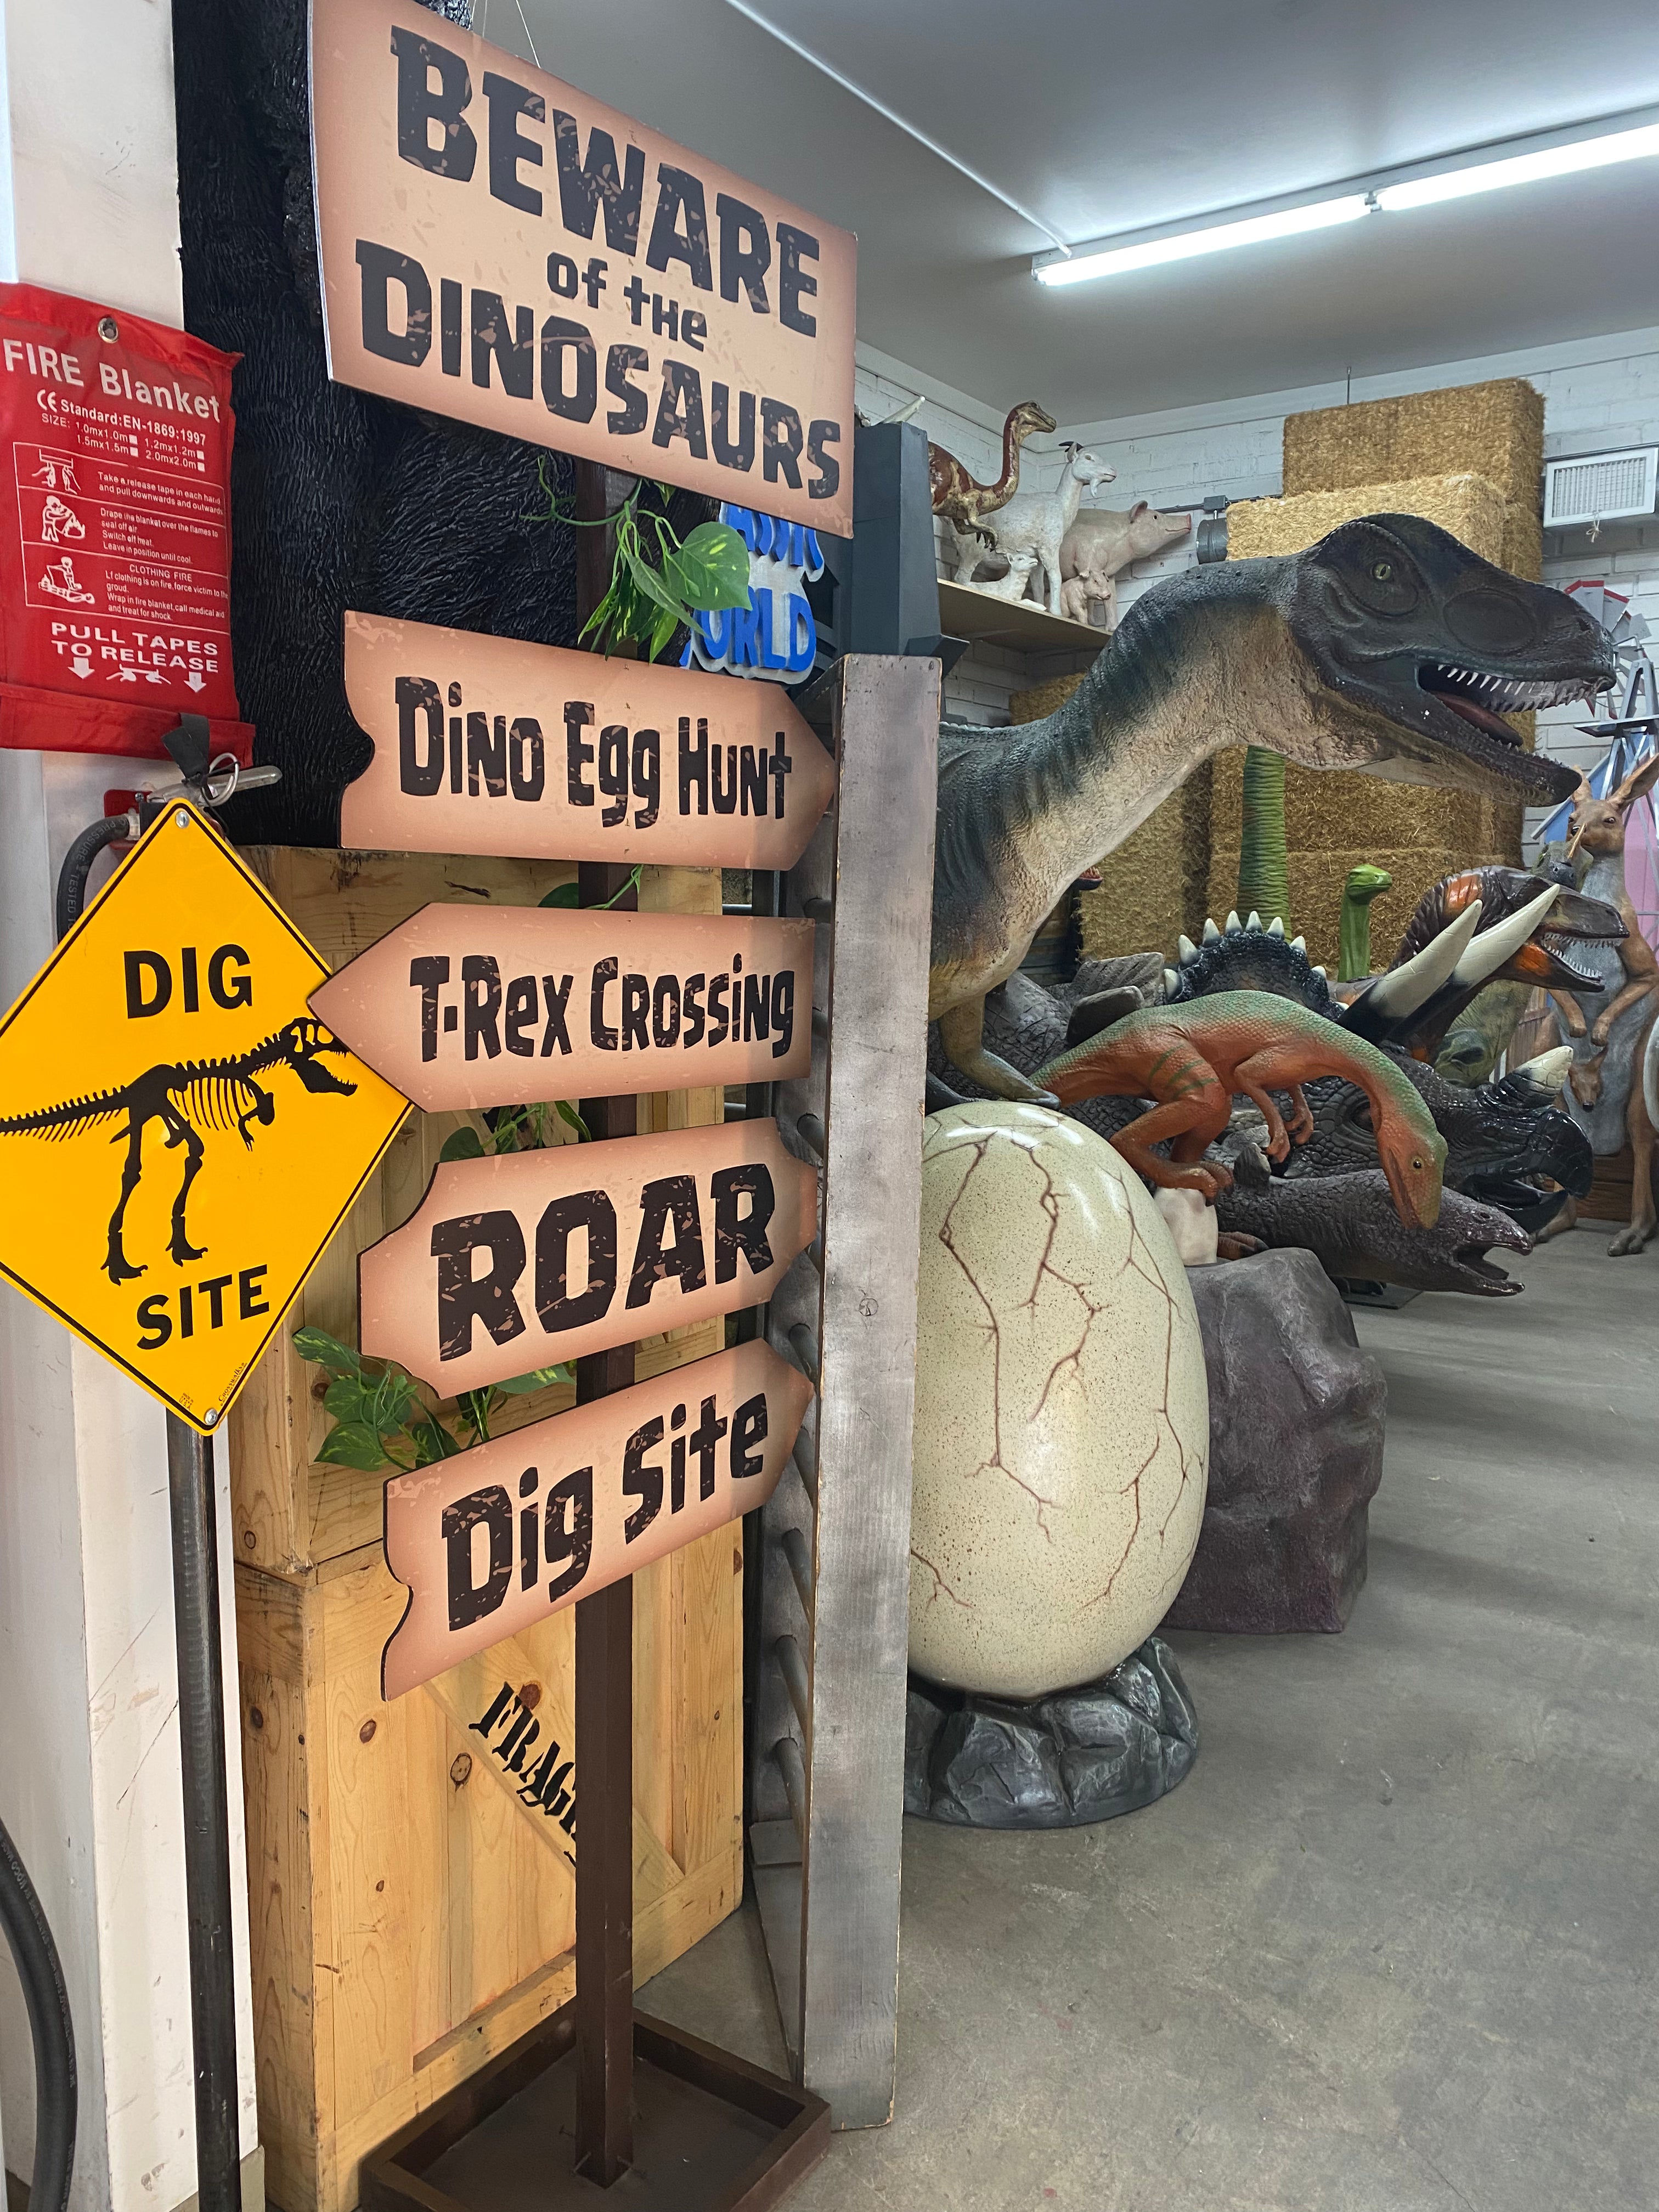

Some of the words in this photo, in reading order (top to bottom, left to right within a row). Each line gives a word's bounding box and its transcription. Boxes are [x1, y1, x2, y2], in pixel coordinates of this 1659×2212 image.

[390, 24, 820, 338] BEWARE
[3, 338, 84, 387] FIRE
[98, 362, 221, 423] Blanket
[355, 238, 841, 500] DINOSAURS
[41, 413, 70, 428] SIZE:
[98, 471, 119, 483] Take
[127, 479, 155, 490] release
[157, 484, 175, 495] tape
[176, 488, 183, 496] in
[184, 490, 202, 500] each
[99, 484, 115, 493] and
[116, 487, 131, 496] pull
[132, 489, 176, 505] downwards
[177, 498, 191, 509] and
[100, 507, 123, 519] Drape
[136, 514, 161, 528] blanket
[162, 522, 177, 531] over
[178, 522, 189, 532] the
[190, 524, 211, 537] flames
[212, 529, 218, 538] to
[101, 520, 117, 529] seal
[103, 529, 126, 541] Switch
[103, 541, 125, 552] Leave
[126, 545, 133, 553] in
[133, 546, 160, 558] position
[161, 551, 176, 561] until
[114, 572, 142, 586] clothing
[143, 576, 149, 585] is
[150, 579, 160, 588] on
[193, 585, 213, 596] victim
[129, 564, 171, 579] CLOTHING
[174, 572, 193, 583] FIRE
[107, 592, 126, 604] Wrap
[127, 596, 134, 604] in
[136, 597, 146, 607] fire
[189, 606, 215, 617] medical
[215, 610, 224, 619] aid
[108, 603, 121, 613] and
[122, 606, 139, 616] treat
[140, 608, 150, 617] for
[51, 622, 125, 644] PULL
[132, 631, 218, 656] TAPES
[679, 585, 817, 673] ORLD
[51, 640, 92, 657] TO
[101, 645, 218, 674] RELEASE
[563, 701, 661, 830] Egg
[123, 943, 253, 1019] DIG
[409, 953, 574, 1063] T-Rex
[589, 951, 795, 1059] Crossing
[430, 1163, 776, 1362] ROAR
[137, 1263, 270, 1351] SITE
[441, 1465, 594, 1632] Dig
[622, 1392, 768, 1545] Site
